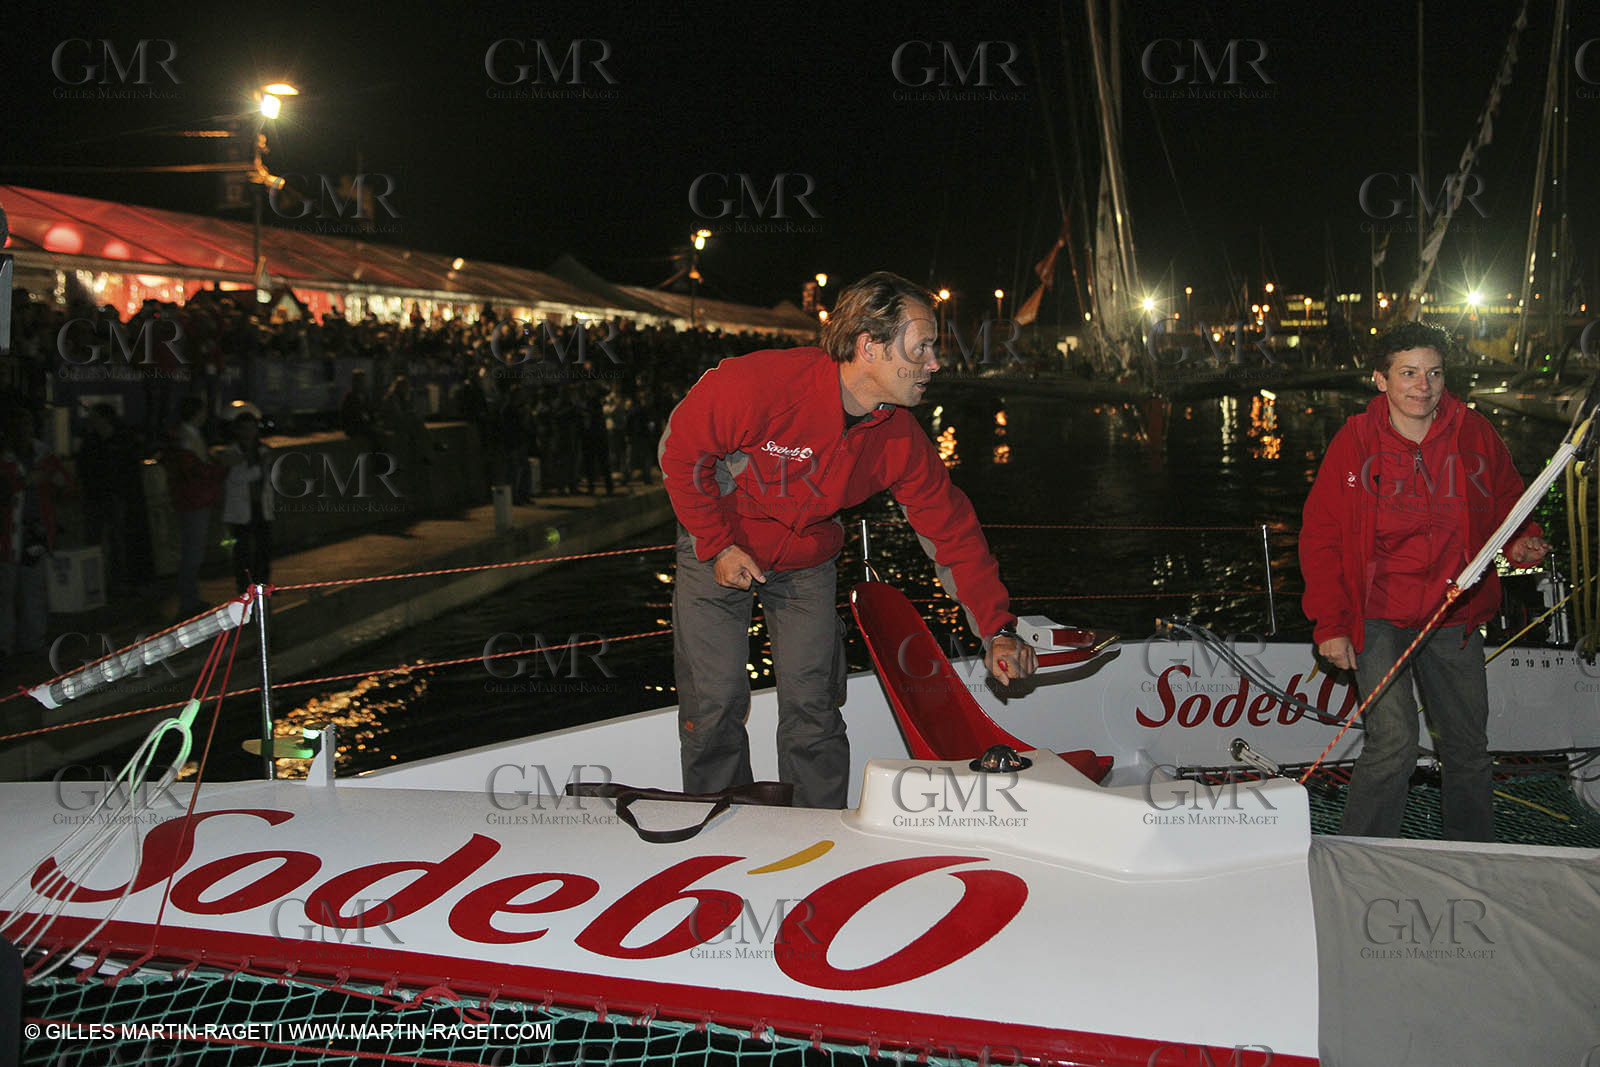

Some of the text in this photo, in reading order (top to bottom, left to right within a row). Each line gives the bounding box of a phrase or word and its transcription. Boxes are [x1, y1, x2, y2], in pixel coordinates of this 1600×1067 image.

[1511, 658, 1519, 667] 20
[1526, 659, 1534, 668] 19
[1541, 660, 1550, 668] 18
[1555, 657, 1564, 665] 17
